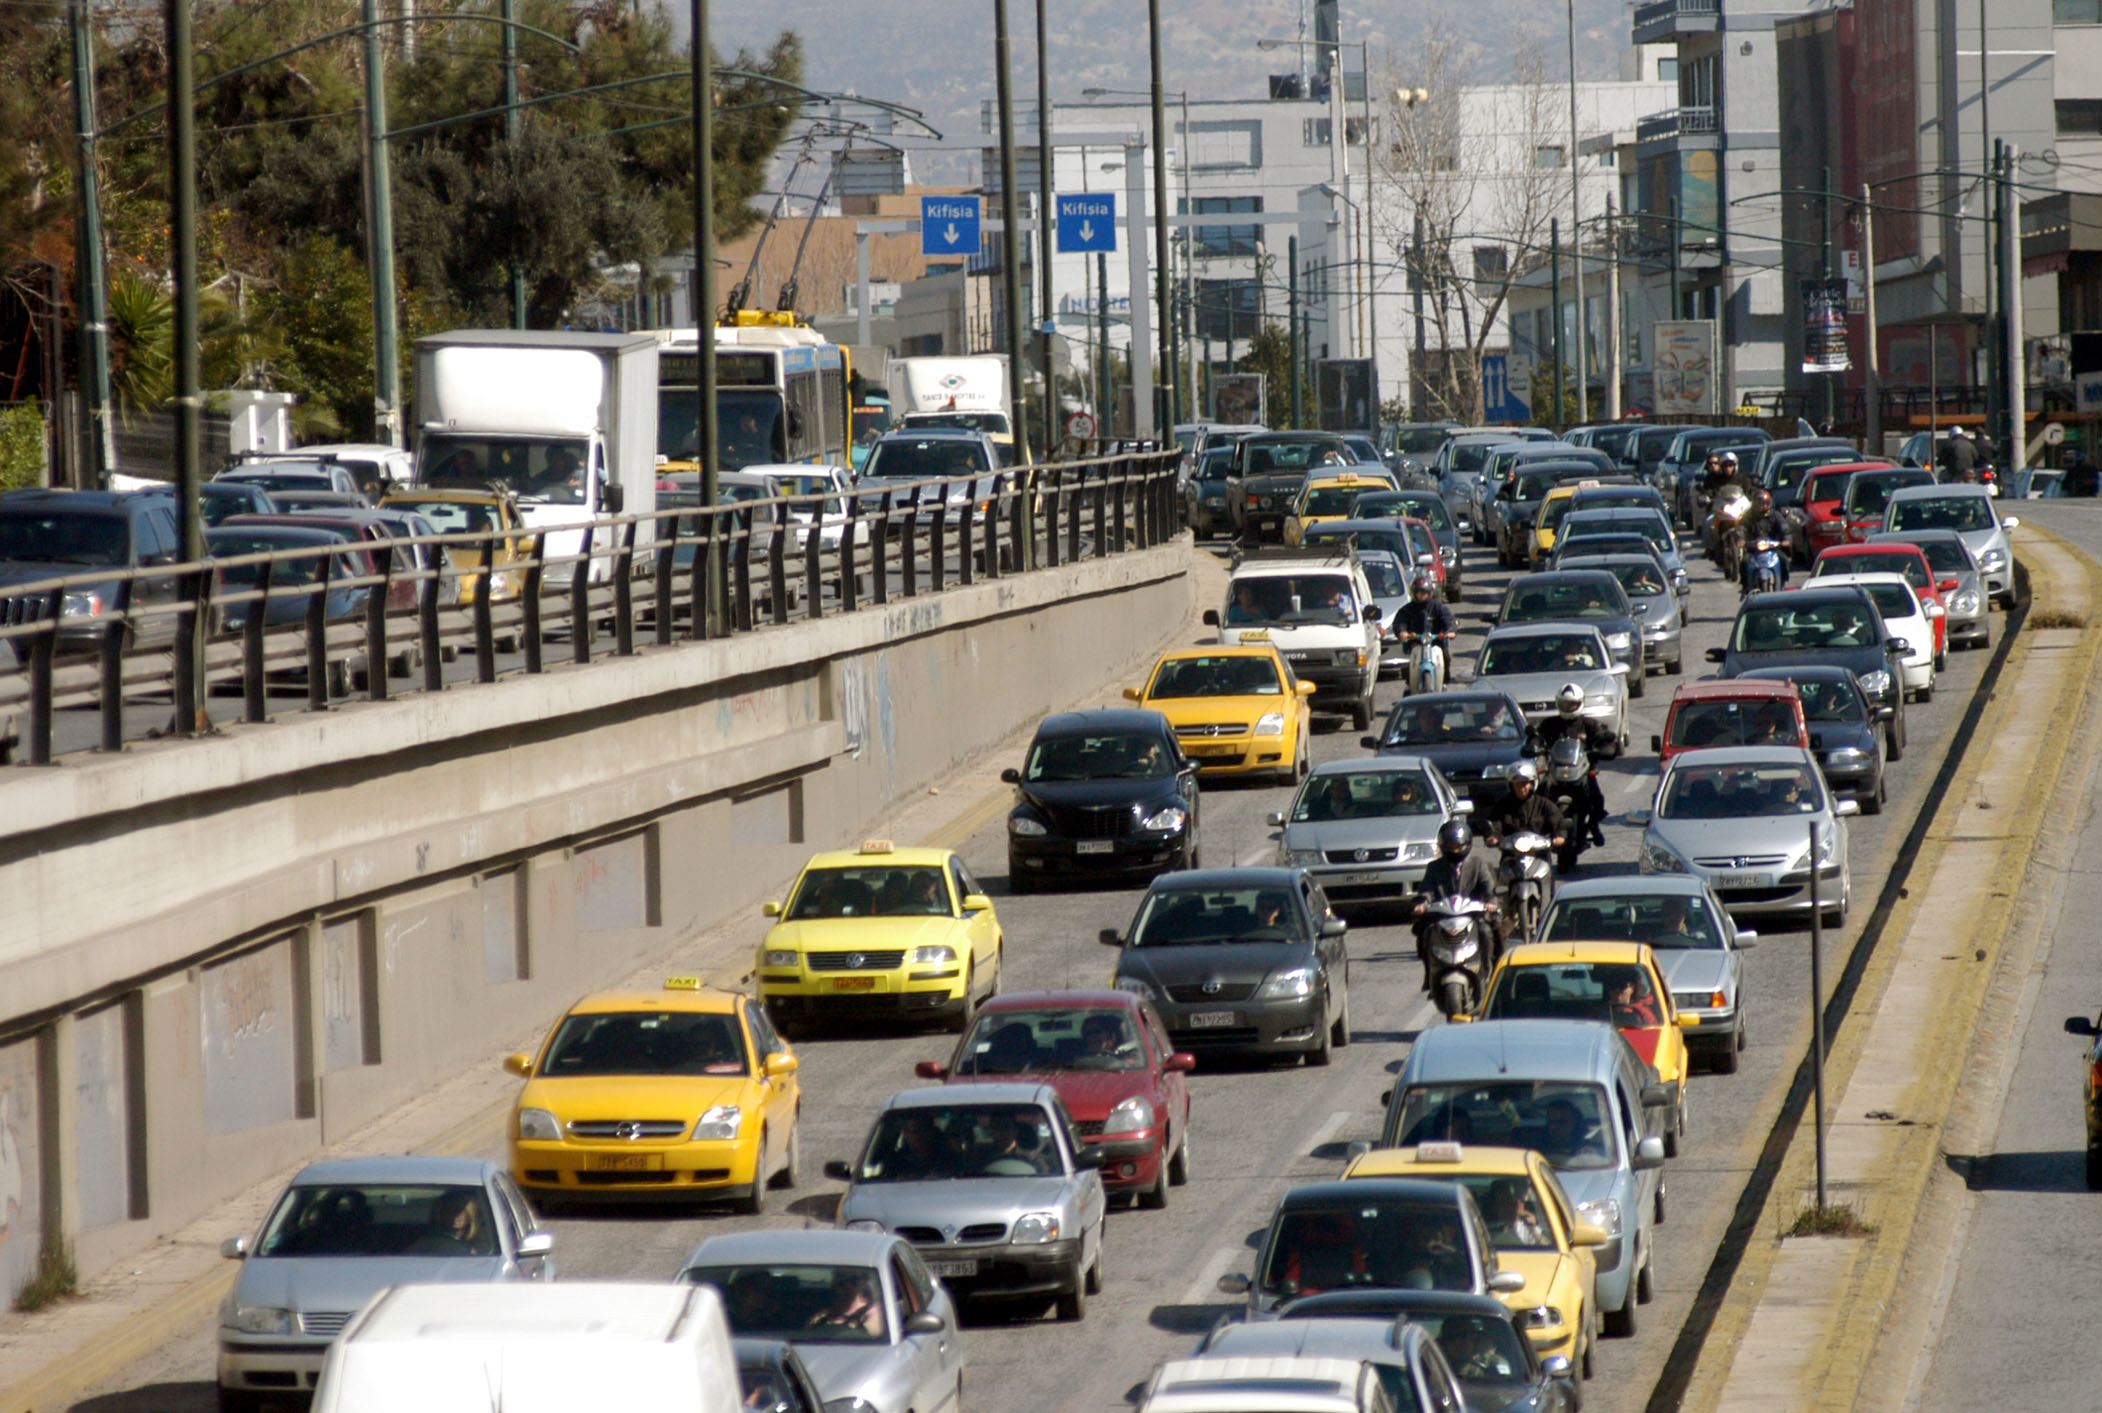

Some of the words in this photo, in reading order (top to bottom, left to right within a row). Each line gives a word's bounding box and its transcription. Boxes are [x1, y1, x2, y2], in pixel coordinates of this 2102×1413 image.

[928, 204, 974, 218] Kifisia
[1062, 201, 1109, 216] Kifisia
[1424, 1146, 1456, 1156] TAXI
